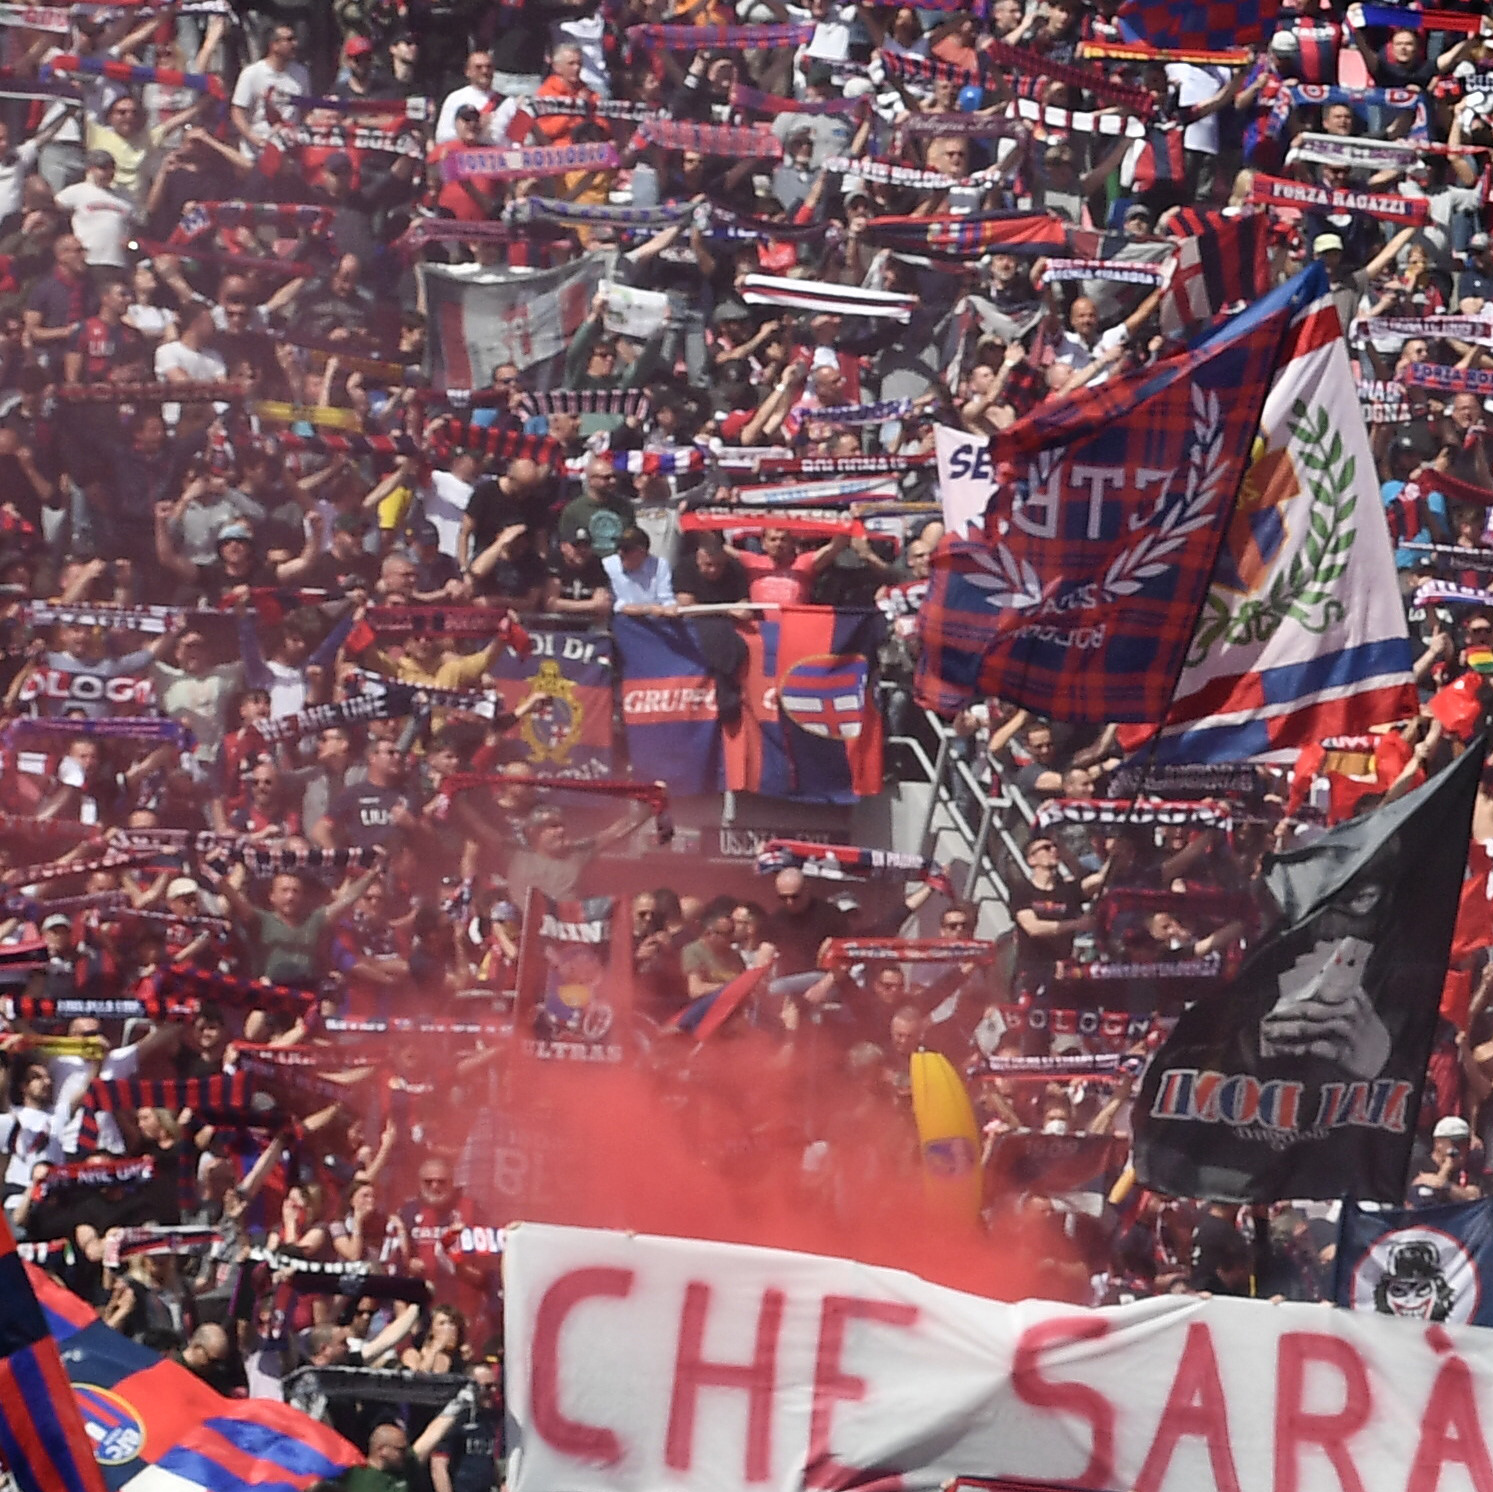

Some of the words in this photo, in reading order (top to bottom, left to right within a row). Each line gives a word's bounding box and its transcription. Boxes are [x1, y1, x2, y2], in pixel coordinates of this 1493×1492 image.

[1272, 182, 1328, 205] FORZA
[1332, 189, 1403, 216] RAGAZZI
[948, 443, 990, 481] SE
